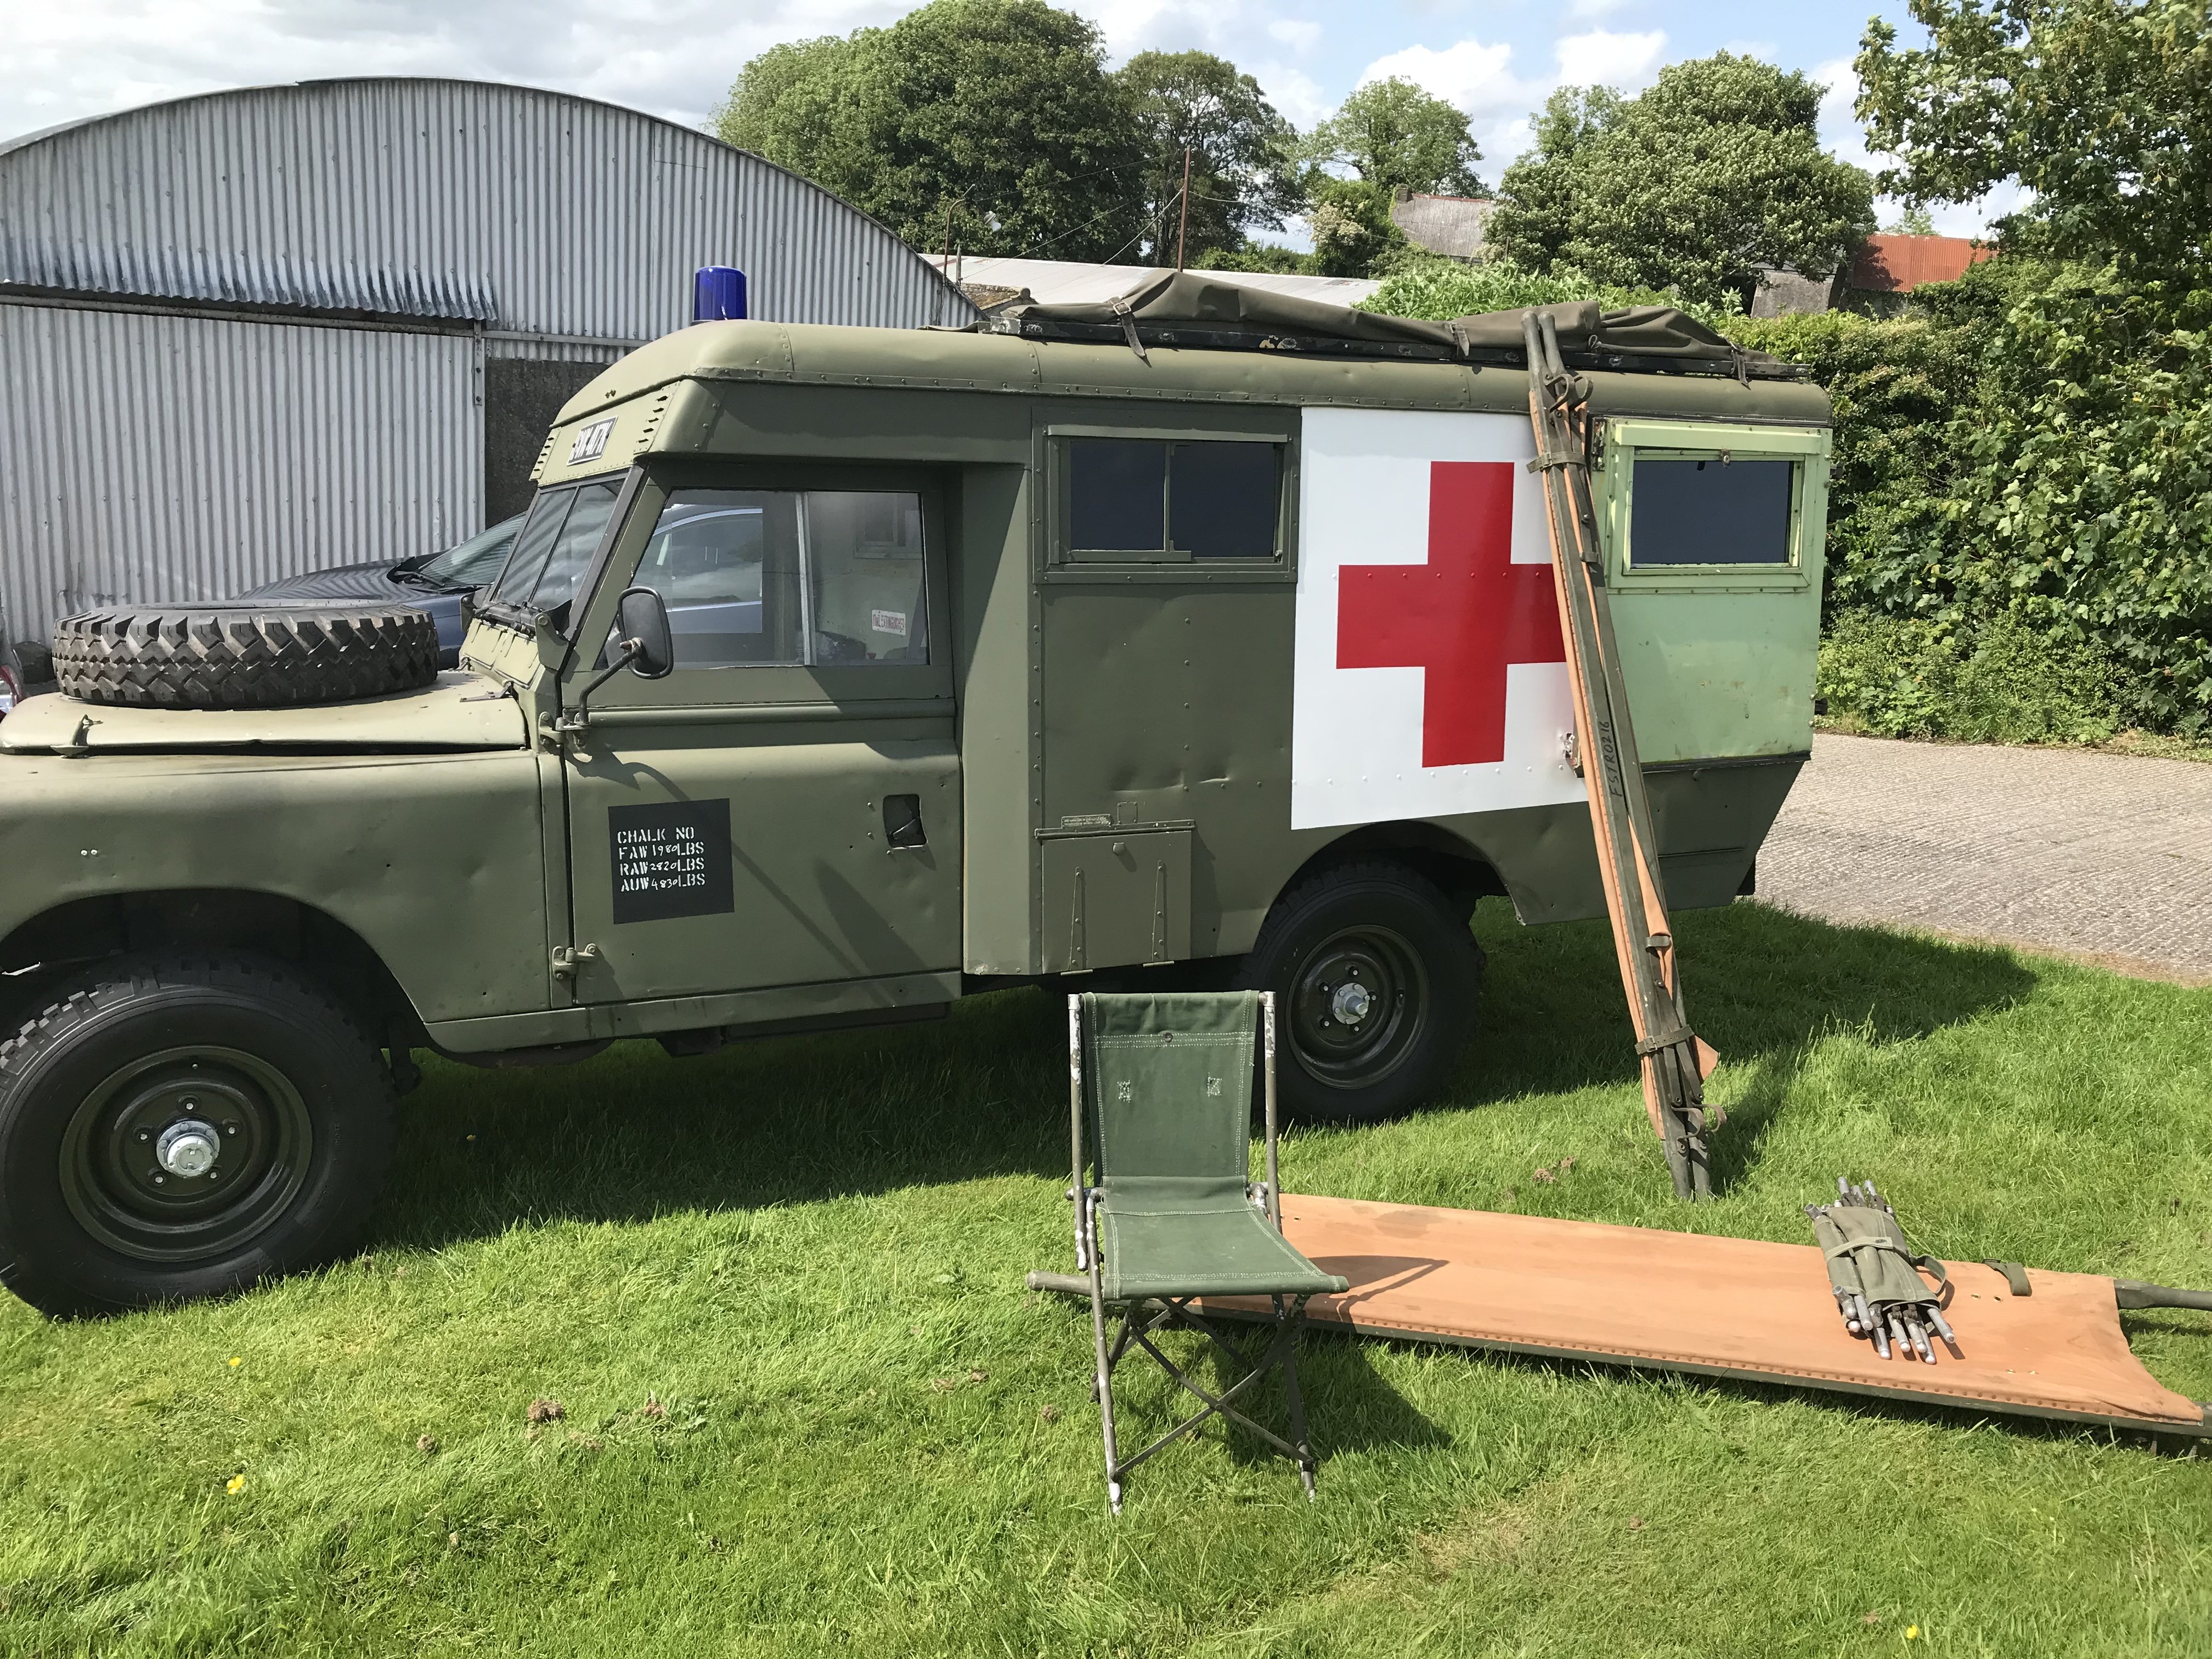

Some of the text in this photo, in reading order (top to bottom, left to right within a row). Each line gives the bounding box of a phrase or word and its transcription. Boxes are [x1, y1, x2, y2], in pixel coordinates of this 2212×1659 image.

[617, 826, 695, 844] CHALK NO
[619, 845, 647, 860] FAW
[620, 861, 648, 876] RAW
[620, 877, 649, 892] AUW
